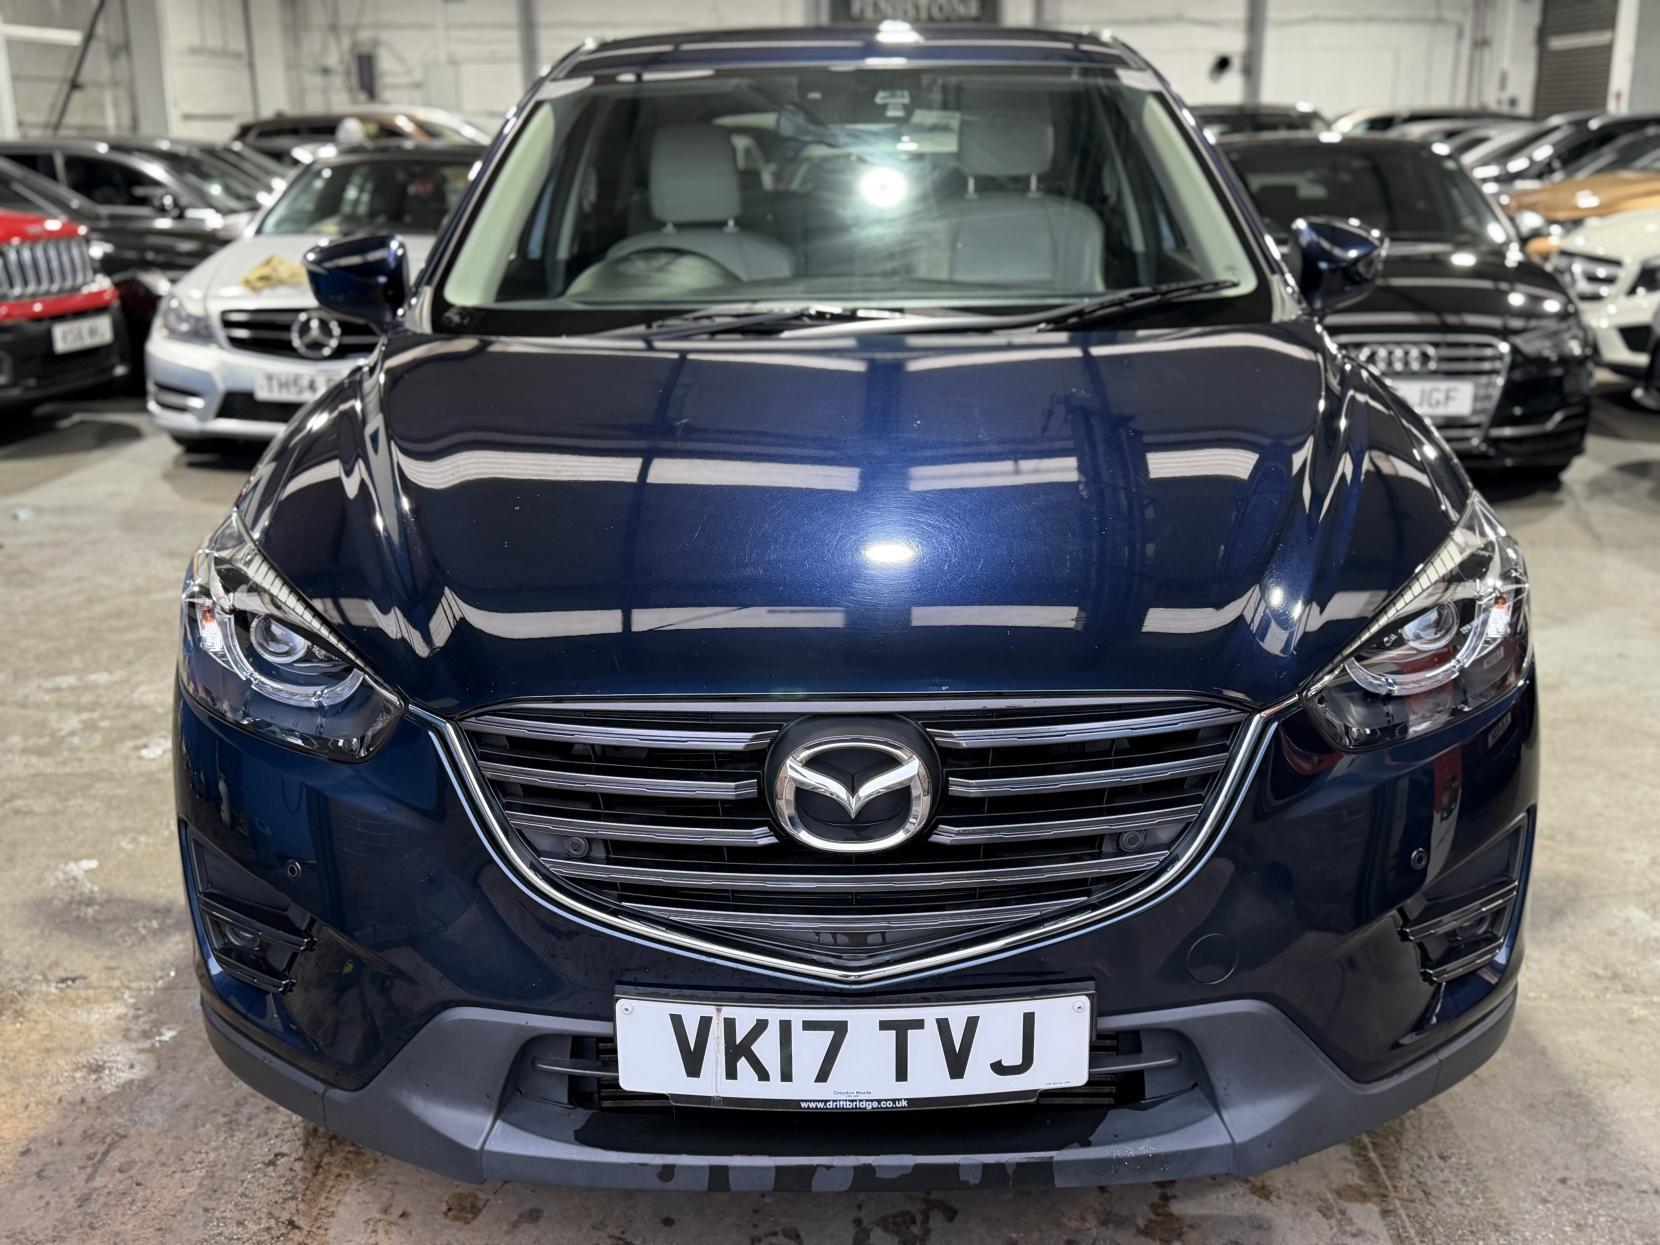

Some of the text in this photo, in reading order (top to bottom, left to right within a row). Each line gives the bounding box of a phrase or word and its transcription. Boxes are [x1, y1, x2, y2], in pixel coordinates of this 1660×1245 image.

[669, 1011, 1036, 1083] VK17 TVJ
[800, 1099, 908, 1110] www.driftbridge.co.uk
